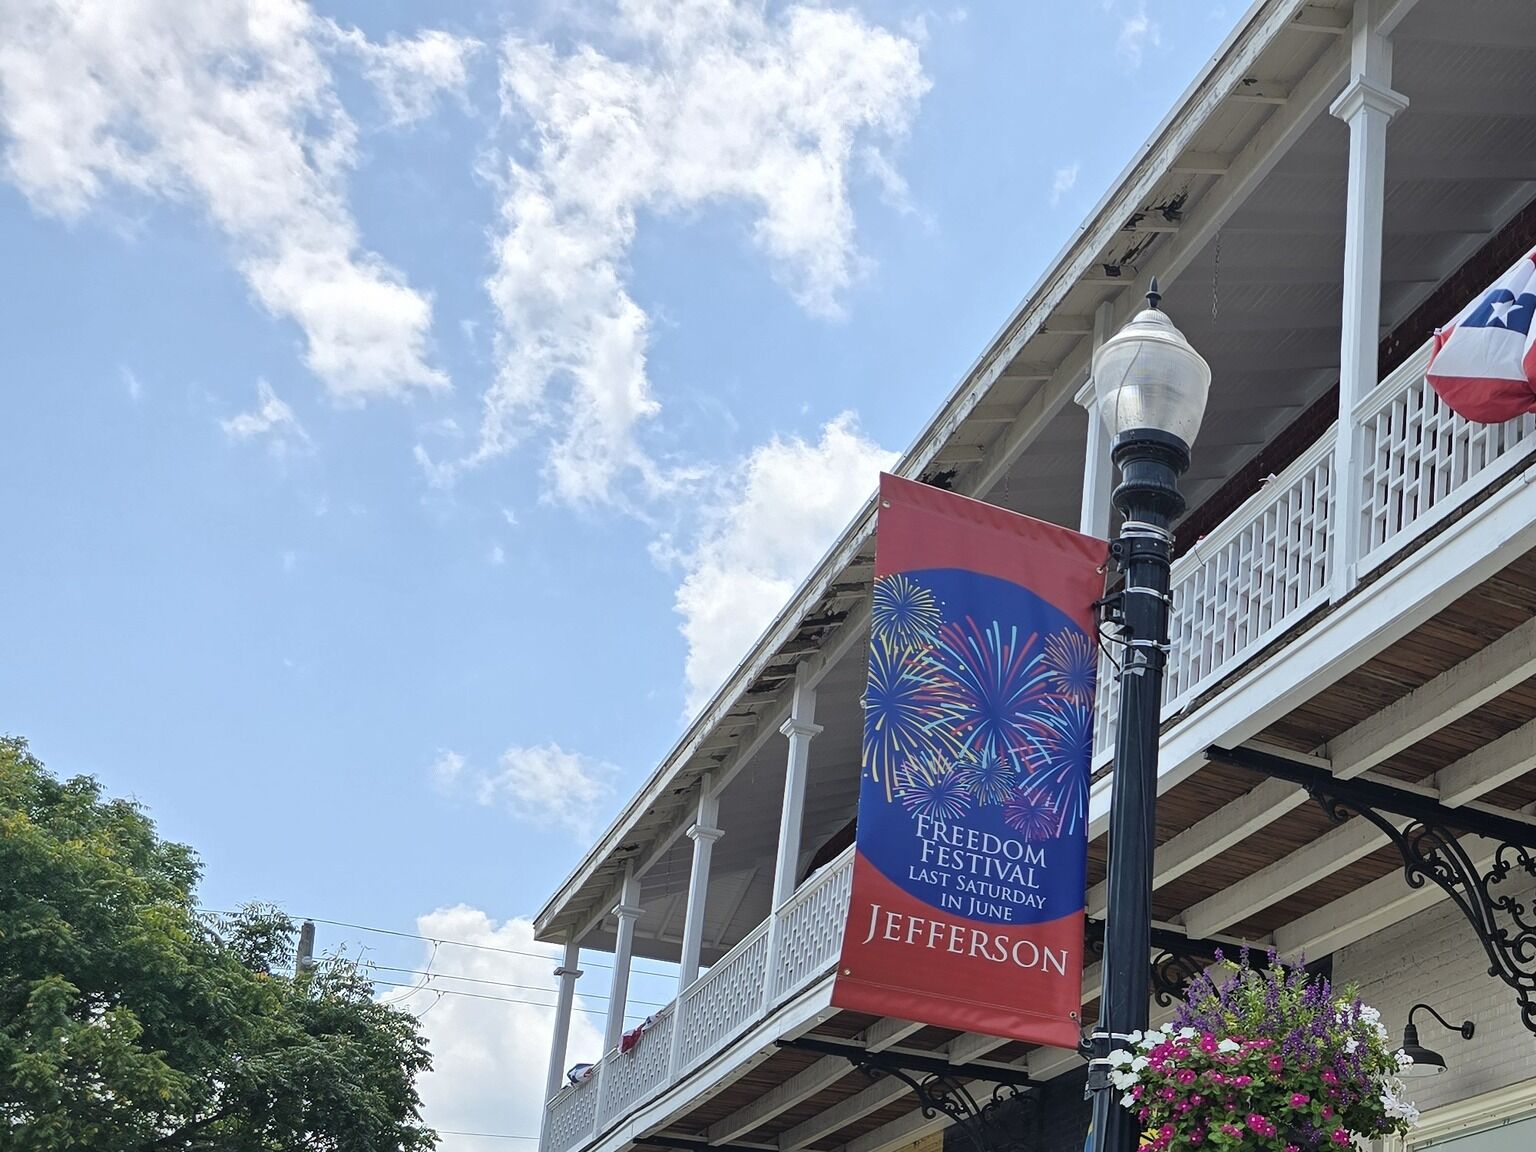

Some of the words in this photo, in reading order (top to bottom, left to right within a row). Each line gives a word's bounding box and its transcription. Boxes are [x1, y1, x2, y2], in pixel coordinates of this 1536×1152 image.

[915, 814, 1048, 868] FREEDOM
[920, 838, 1040, 889] FESTIVAL
[908, 866, 951, 887] LAST
[956, 875, 1046, 909] SATURDAY
[940, 893, 962, 910] IN
[968, 897, 1013, 921] JUNE
[862, 904, 1068, 976] JEFFERSON
